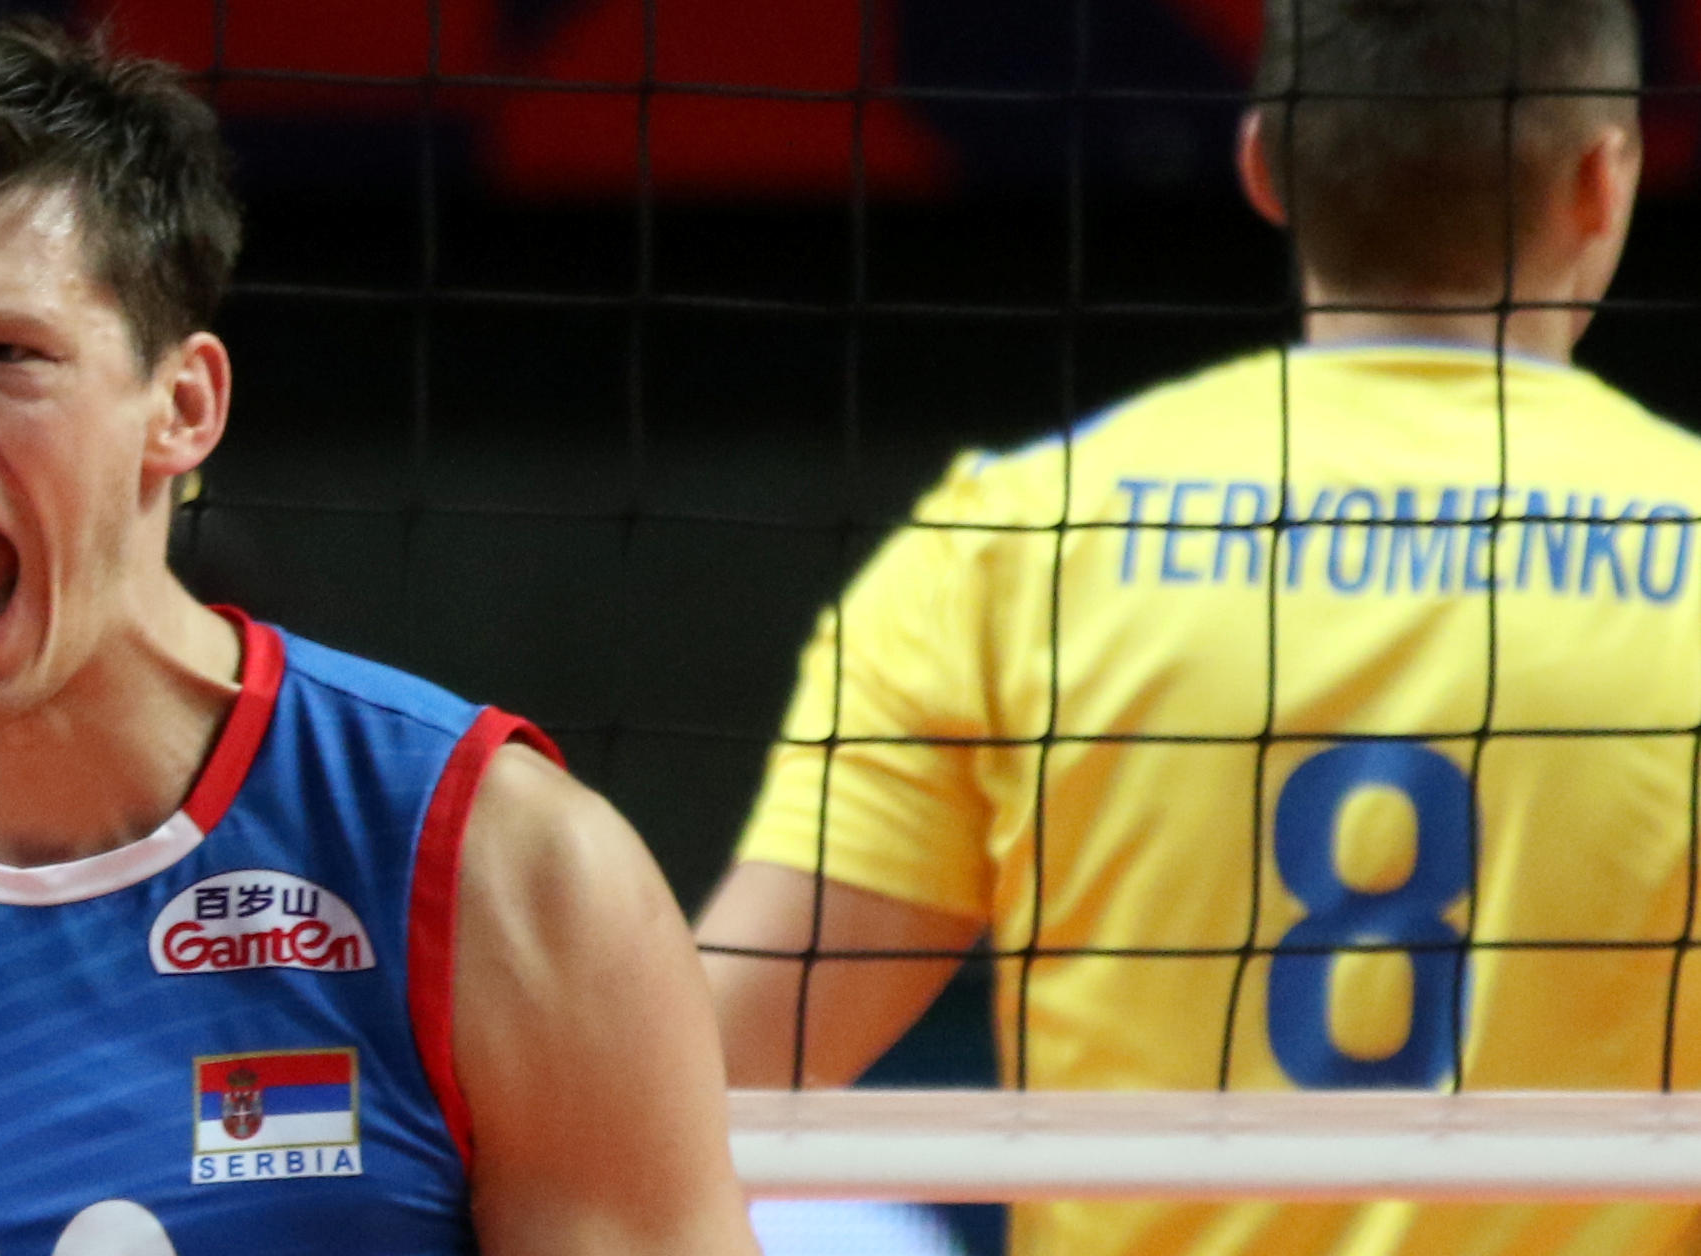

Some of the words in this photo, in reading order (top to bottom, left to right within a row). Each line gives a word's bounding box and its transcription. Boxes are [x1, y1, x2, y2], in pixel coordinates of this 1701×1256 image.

[1117, 477, 1697, 607] TERYOMENKO
[194, 883, 320, 920] 百岁山
[1265, 738, 1483, 1091] 8
[198, 1148, 355, 1180] SERBIA
